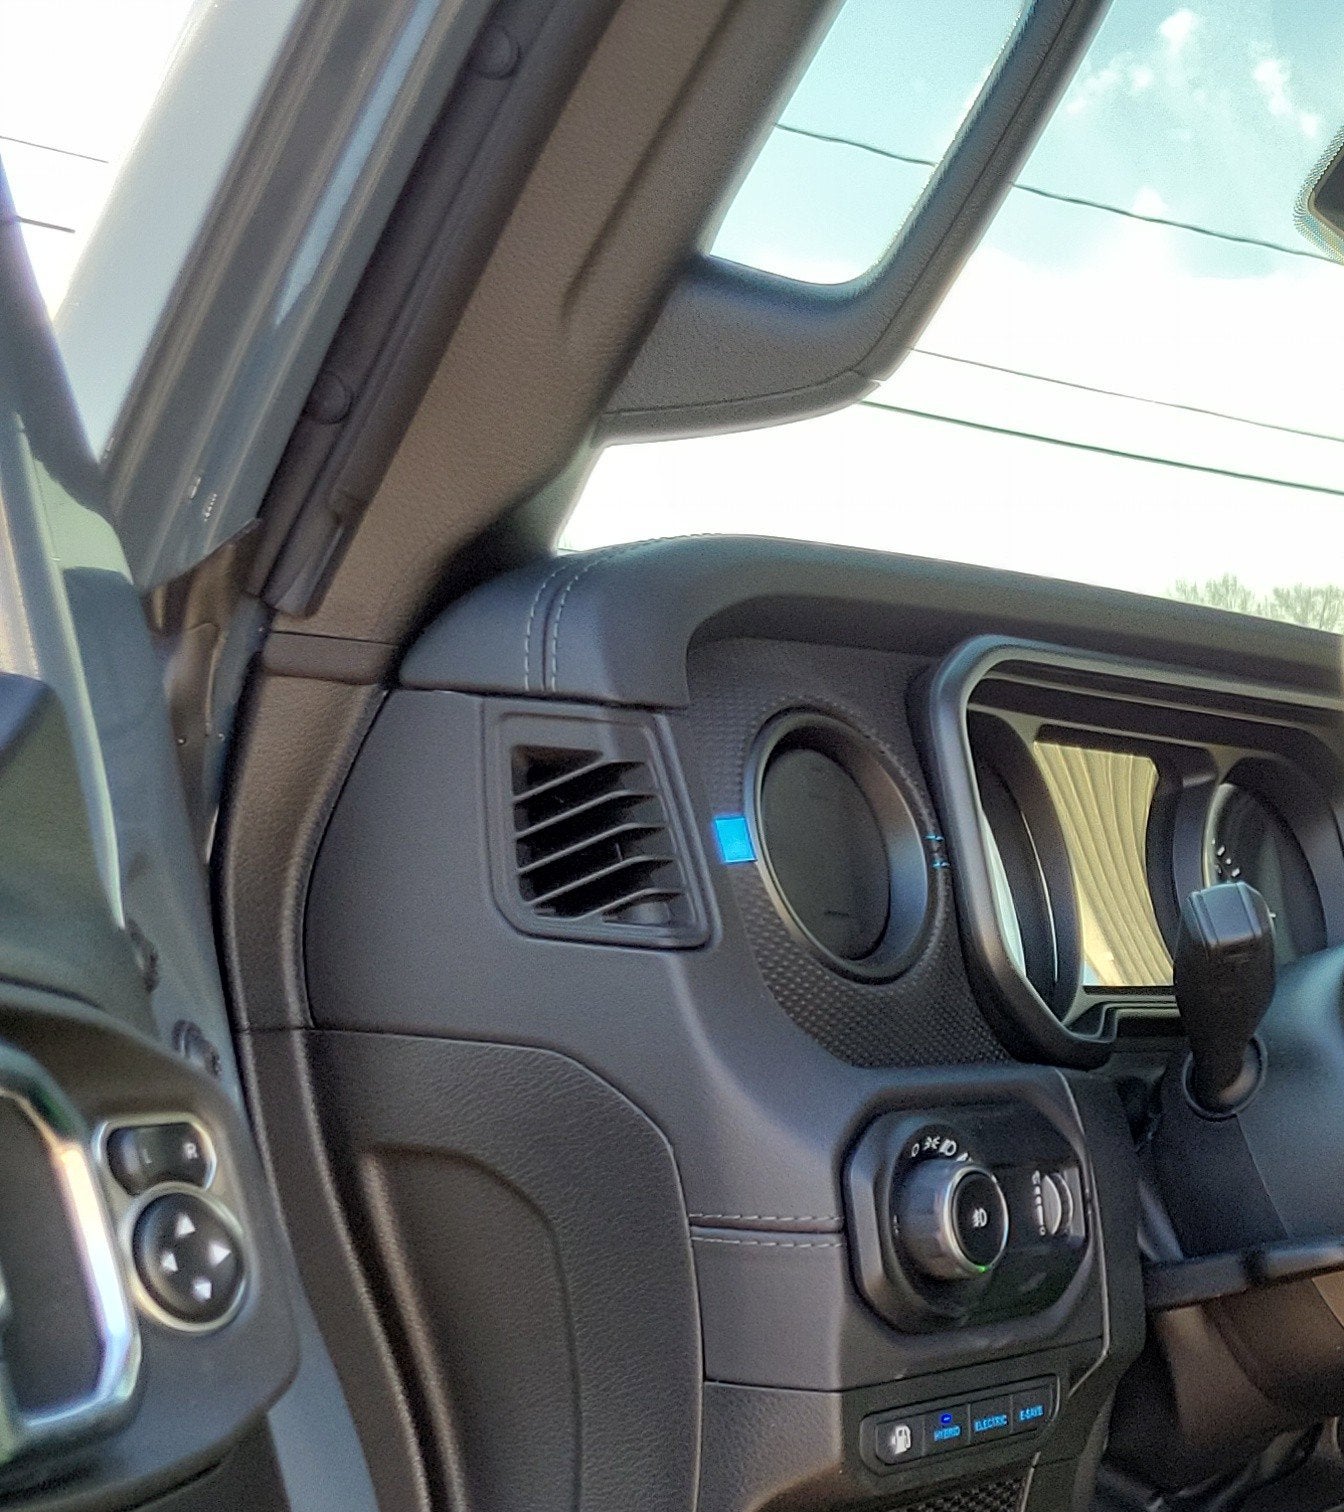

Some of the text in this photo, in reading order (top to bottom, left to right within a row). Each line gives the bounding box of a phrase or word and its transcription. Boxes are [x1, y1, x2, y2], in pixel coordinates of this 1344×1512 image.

[184, 1141, 198, 1160] R
[1019, 1405, 1044, 1421] E-SAVE
[974, 1414, 1008, 1432] ELECTRIC
[933, 1425, 961, 1441] HYBRID
